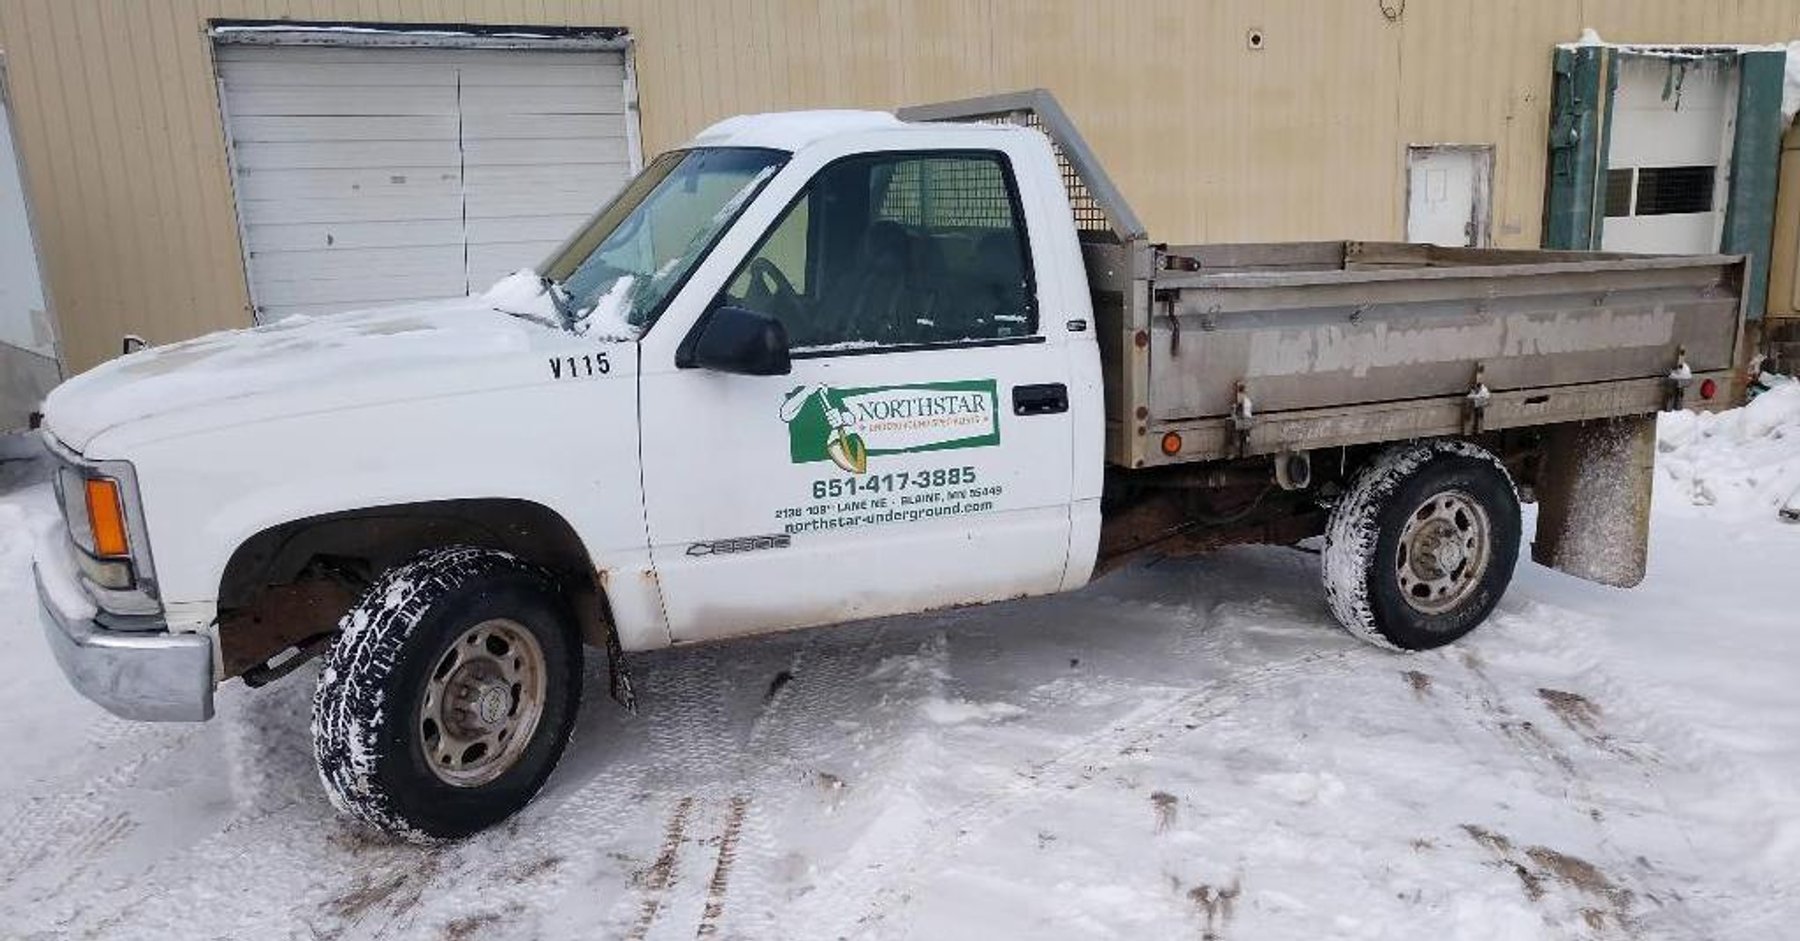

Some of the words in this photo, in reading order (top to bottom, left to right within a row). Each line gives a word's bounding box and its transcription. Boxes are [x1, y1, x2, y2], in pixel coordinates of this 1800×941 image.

[549, 352, 610, 379] V115
[857, 393, 985, 420] NORTHSTAR
[813, 466, 976, 499] 651-417-3885
[837, 500, 868, 513] LANE
[871, 497, 888, 509] NE
[969, 485, 1003, 498] 55449
[785, 501, 993, 535] northstar-underground.com
